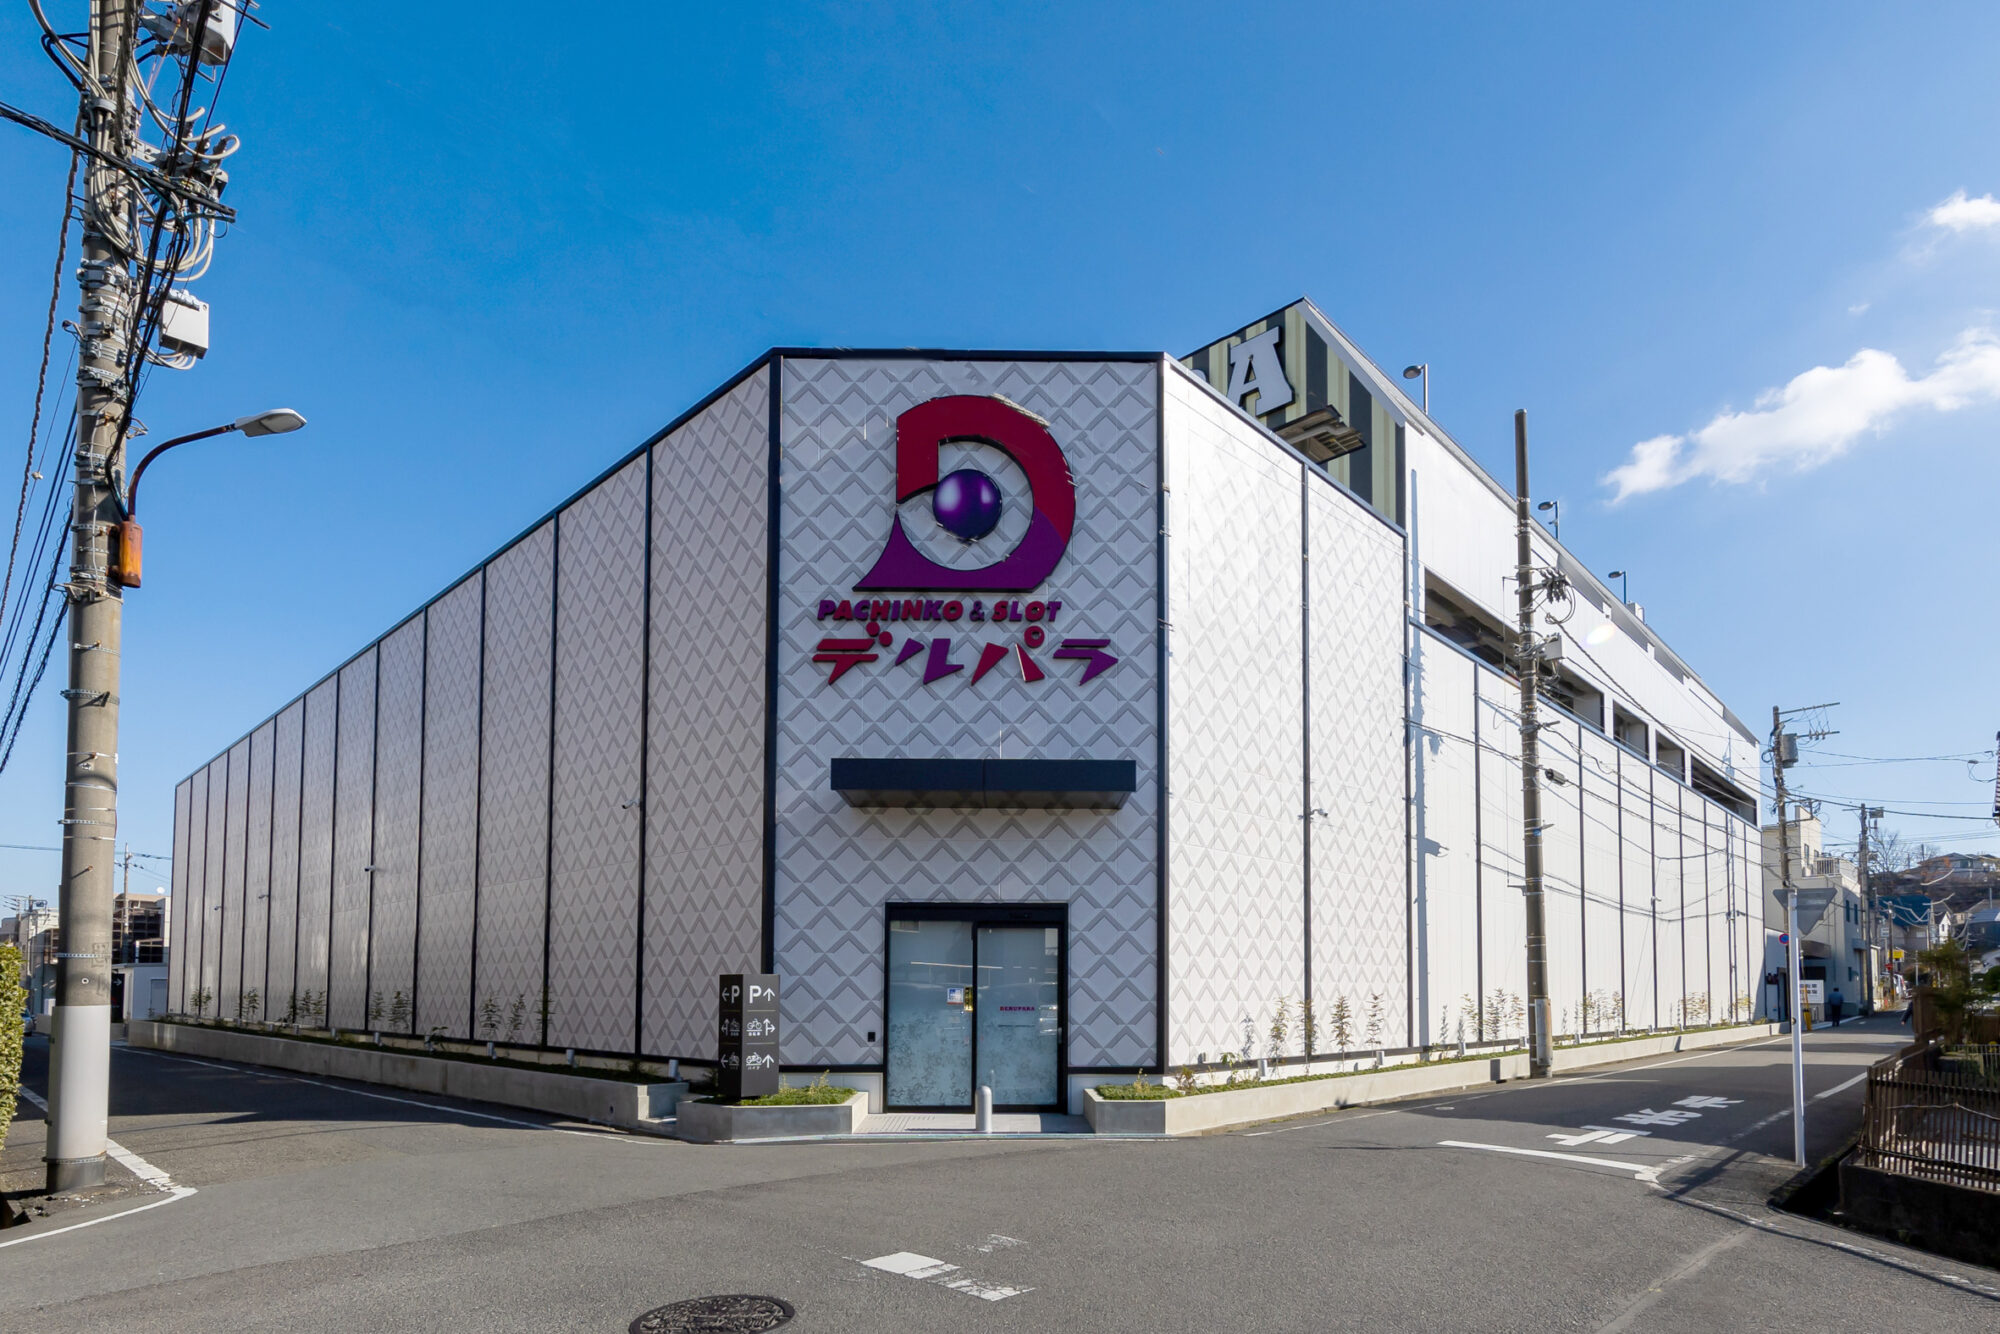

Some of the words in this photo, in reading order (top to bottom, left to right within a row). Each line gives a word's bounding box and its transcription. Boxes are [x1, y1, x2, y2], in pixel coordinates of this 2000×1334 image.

[817, 600, 963, 621] PACHINKO
[971, 602, 985, 621] &
[991, 601, 1063, 622] SLOT
[812, 622, 1119, 685] デルパラ
[731, 985, 740, 1003] P
[749, 985, 761, 1004] P
[1546, 1095, 1744, 1146] 止まれ
